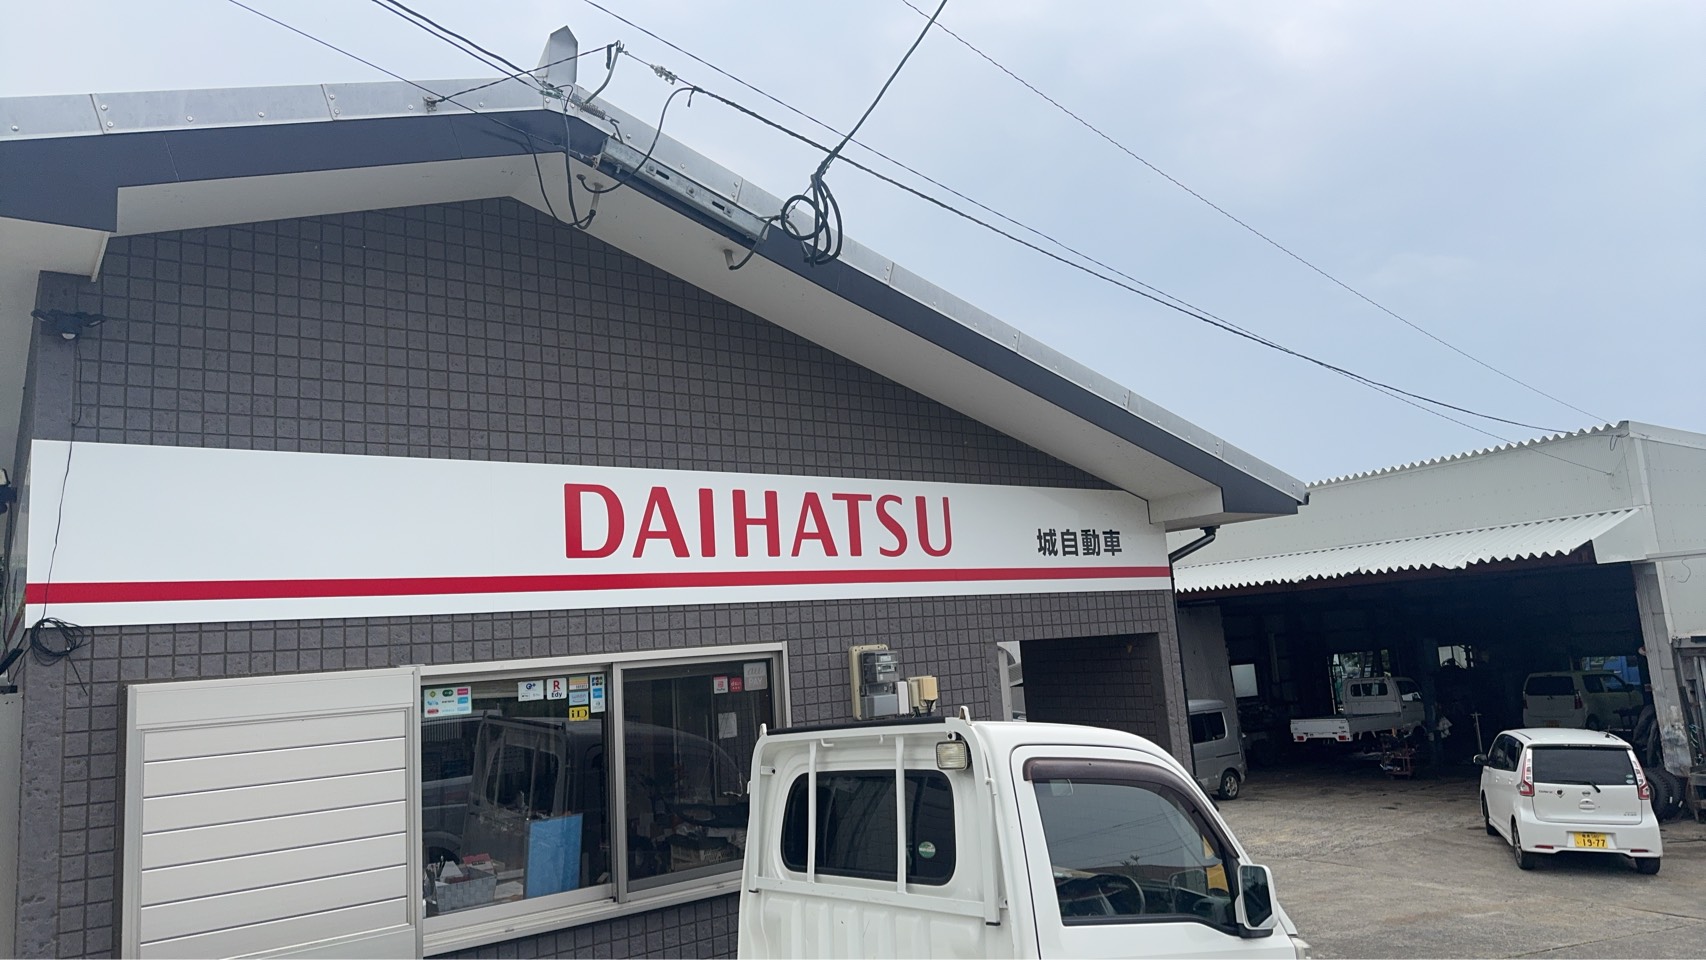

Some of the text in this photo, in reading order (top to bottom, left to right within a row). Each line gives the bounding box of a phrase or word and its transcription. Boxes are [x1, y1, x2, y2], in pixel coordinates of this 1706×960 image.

[563, 483, 953, 559] DAIHATSU
[1036, 528, 1123, 557] 城自動車
[553, 680, 561, 690] R
